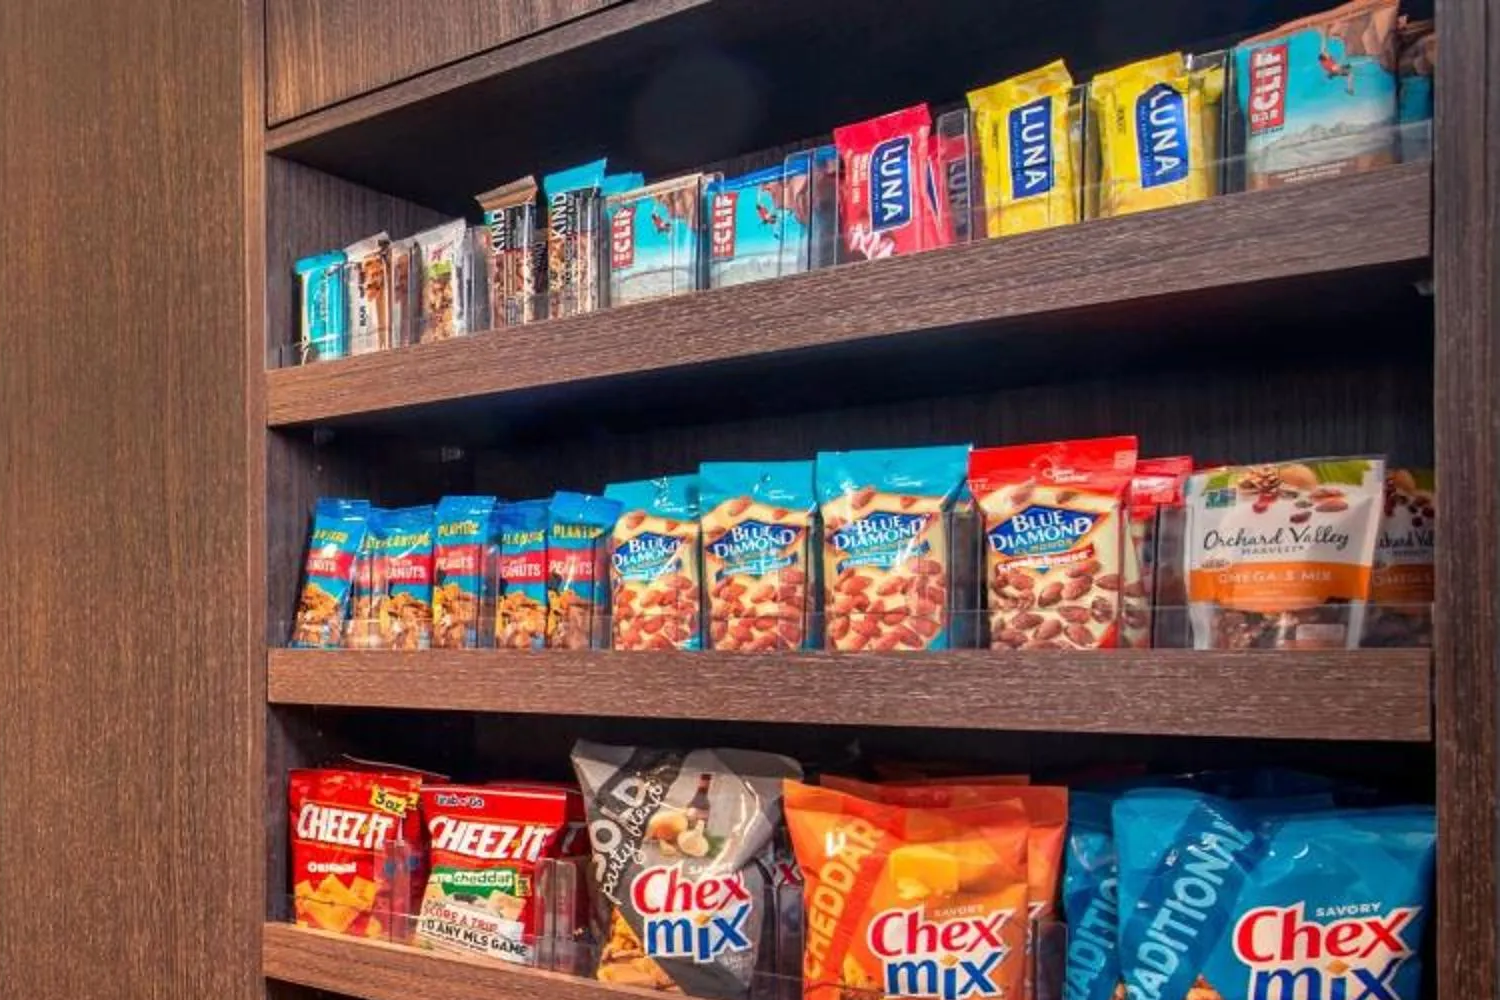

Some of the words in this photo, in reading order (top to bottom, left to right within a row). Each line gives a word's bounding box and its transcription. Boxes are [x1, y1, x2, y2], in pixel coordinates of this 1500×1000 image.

[1253, 53, 1282, 112] CLIF
[1020, 105, 1048, 189] LUNA
[1150, 90, 1181, 177] LUNA
[880, 145, 904, 221] LUNA
[492, 207, 506, 255] KIND
[550, 192, 567, 239] KIND
[612, 208, 633, 252] CLIF
[713, 195, 734, 242] CLIF
[732, 525, 771, 542] BLUE
[833, 517, 925, 551] DIAMOND
[857, 515, 901, 534] BLUE
[988, 516, 1093, 552] DIAMOND
[1011, 509, 1066, 534] BLUE
[1203, 527, 1284, 551] Orchard
[1288, 524, 1349, 551] Valley
[629, 537, 663, 553] BLUE
[714, 529, 796, 558] DIAMOND
[1301, 570, 1333, 582] MIX
[632, 866, 750, 915] Chex
[933, 903, 985, 917] SAVORY
[1315, 902, 1381, 918] SAVORY
[436, 922, 461, 938] ANY
[463, 930, 490, 947] MLS
[646, 902, 751, 962] mix
[870, 909, 1014, 957] Chex
[1235, 907, 1410, 964] Chex
